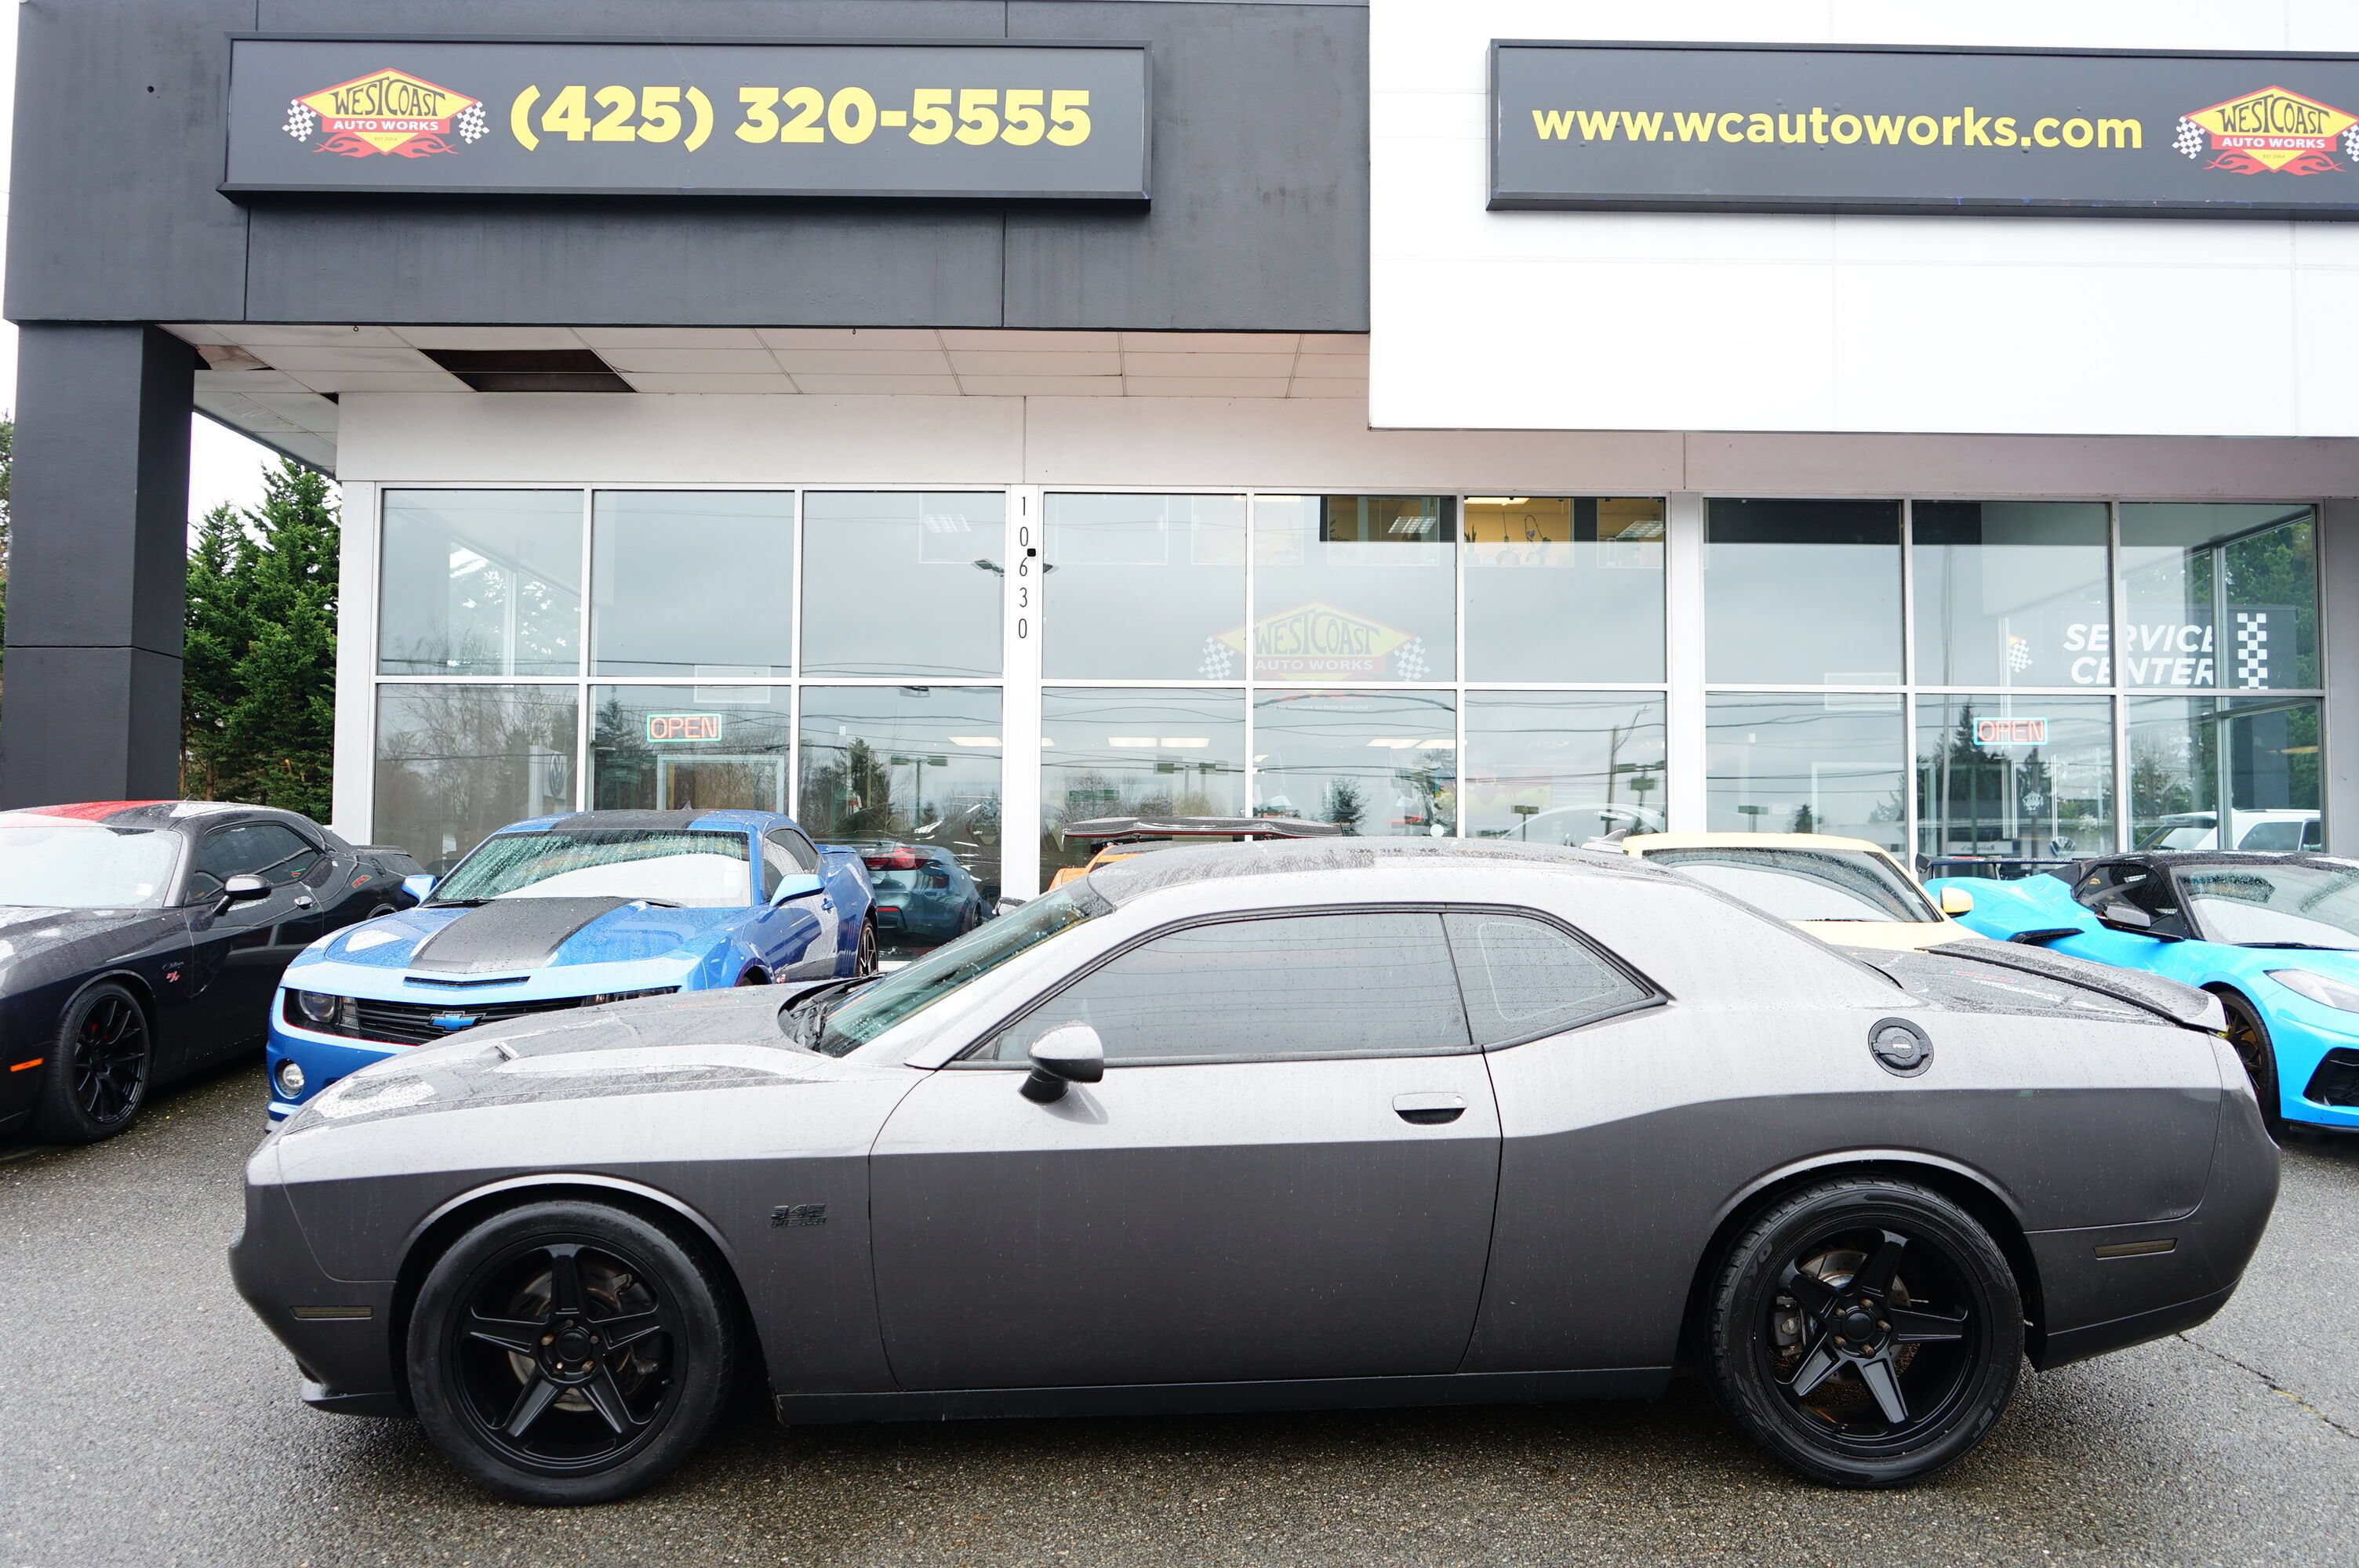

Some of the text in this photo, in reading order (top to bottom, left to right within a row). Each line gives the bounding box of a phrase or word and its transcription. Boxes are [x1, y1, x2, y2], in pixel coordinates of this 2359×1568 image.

[329, 76, 446, 116] WESTCOAST
[2215, 93, 2331, 134] WESTCOAST
[333, 120, 439, 131] AUTO WORKS
[511, 85, 1091, 152] (425) 320-5555
[1532, 107, 2143, 148] www.wcautoworks.com
[2222, 137, 2326, 149] AUTO WORKS
[1018, 496, 1029, 639] 10630
[1253, 608, 1380, 655] WESTCOAST
[1255, 659, 1373, 671] AUTO WORKS
[650, 717, 718, 739] OPEN
[1978, 720, 2045, 742] OPEN
